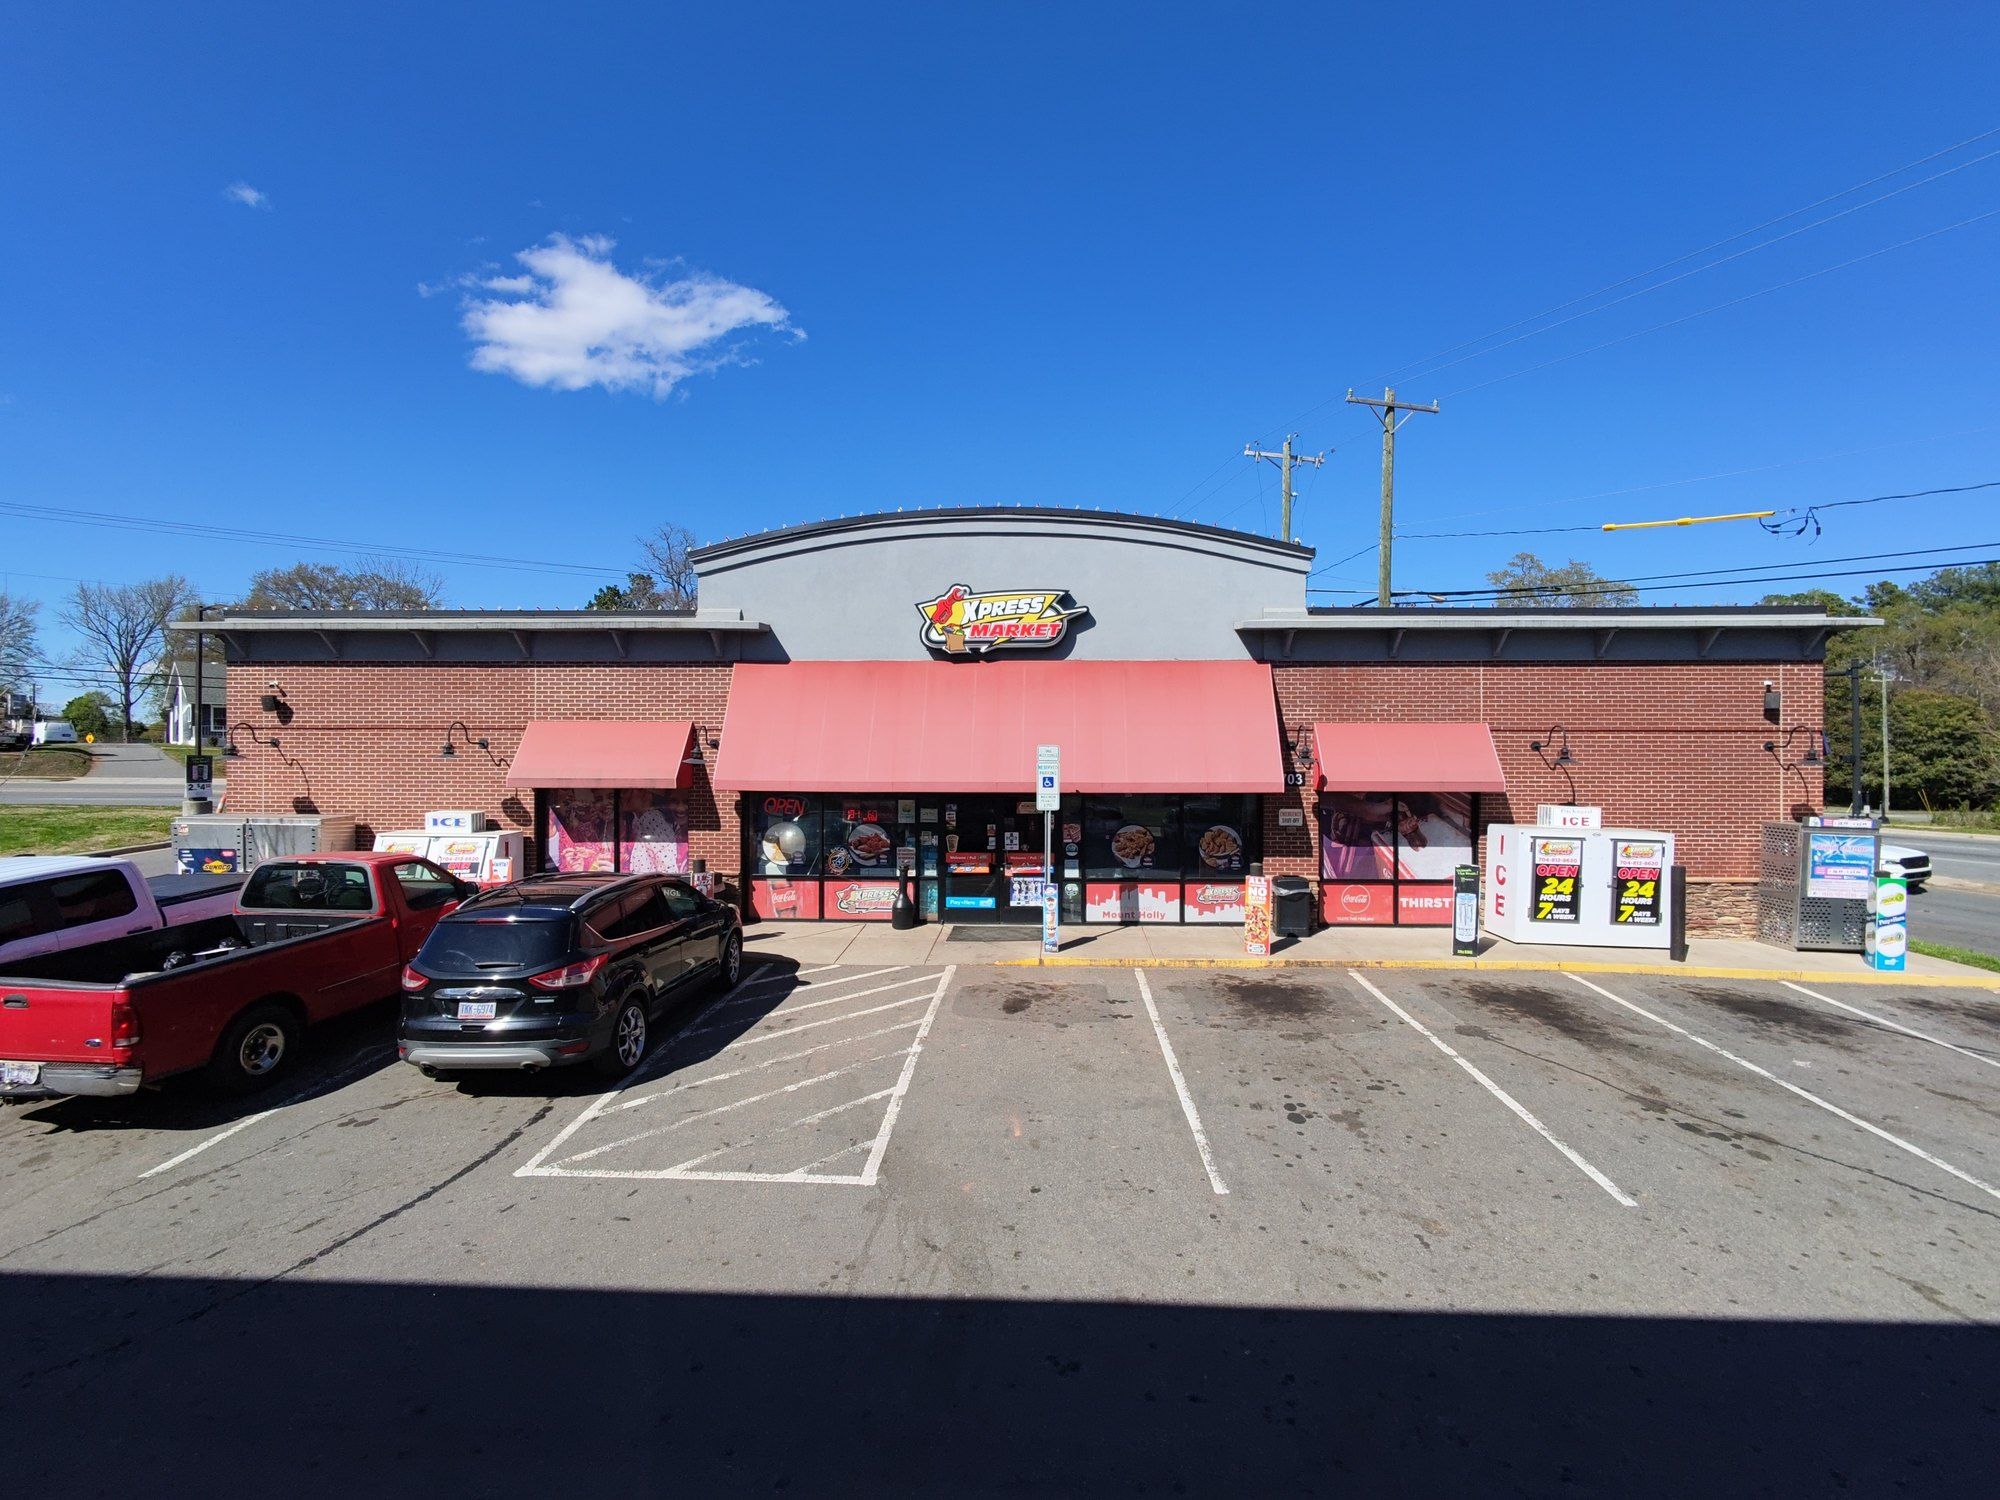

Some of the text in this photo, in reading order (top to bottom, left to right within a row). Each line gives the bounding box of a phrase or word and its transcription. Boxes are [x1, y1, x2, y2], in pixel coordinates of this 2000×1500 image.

[961, 596, 1046, 624] XPRESS
[969, 623, 1062, 638] MARKET
[1284, 773, 1303, 785] 03
[764, 797, 805, 815] OPEN
[432, 818, 467, 827] ICE
[1562, 817, 1590, 827] ICE
[1495, 835, 1507, 917] ICE
[1536, 864, 1579, 877] OPEN
[1618, 867, 1660, 880] OPEN
[1249, 887, 1267, 897] NO
[1542, 878, 1574, 895] 24
[1623, 881, 1655, 898] 24
[772, 889, 797, 905] Coca-Cola
[1343, 895, 1368, 904] Coca-Cola
[1400, 898, 1453, 908] THIRST
[1540, 894, 1572, 902] HOURS
[1620, 897, 1653, 905] HOURS
[1102, 911, 1166, 920] Mount Holly
[1536, 902, 1554, 919] 7
[1617, 905, 1635, 922] 7
